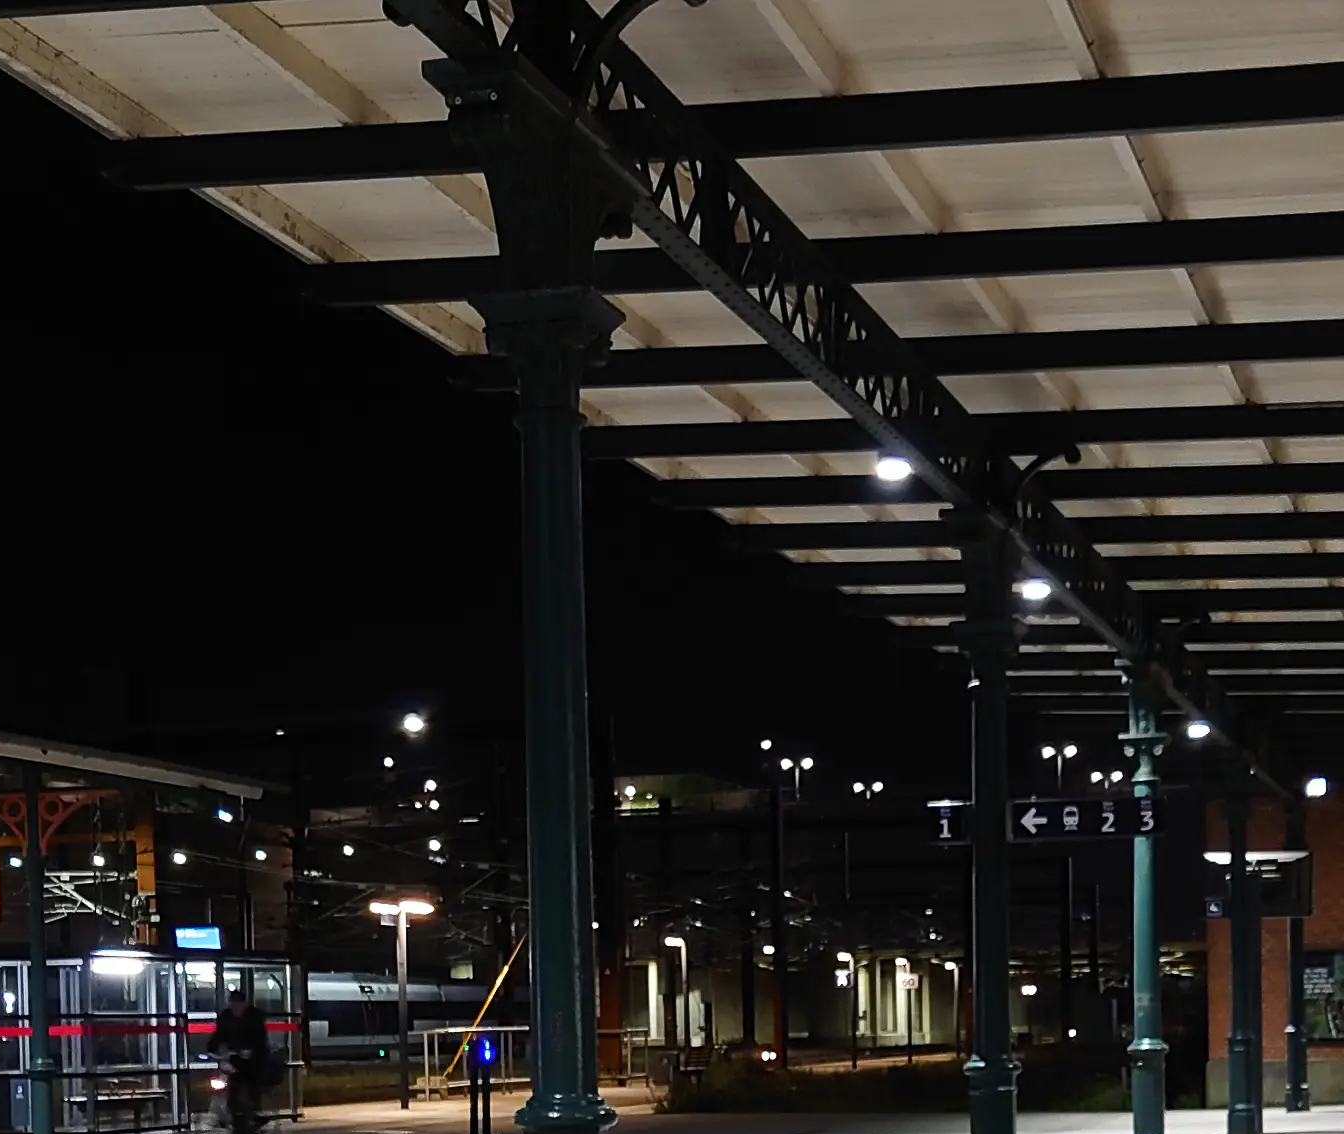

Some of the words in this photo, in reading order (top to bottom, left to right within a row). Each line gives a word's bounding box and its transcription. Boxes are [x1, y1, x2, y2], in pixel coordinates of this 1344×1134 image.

[939, 819, 952, 838] 1
[1101, 813, 1115, 832] 2
[1140, 811, 1154, 831] 3
